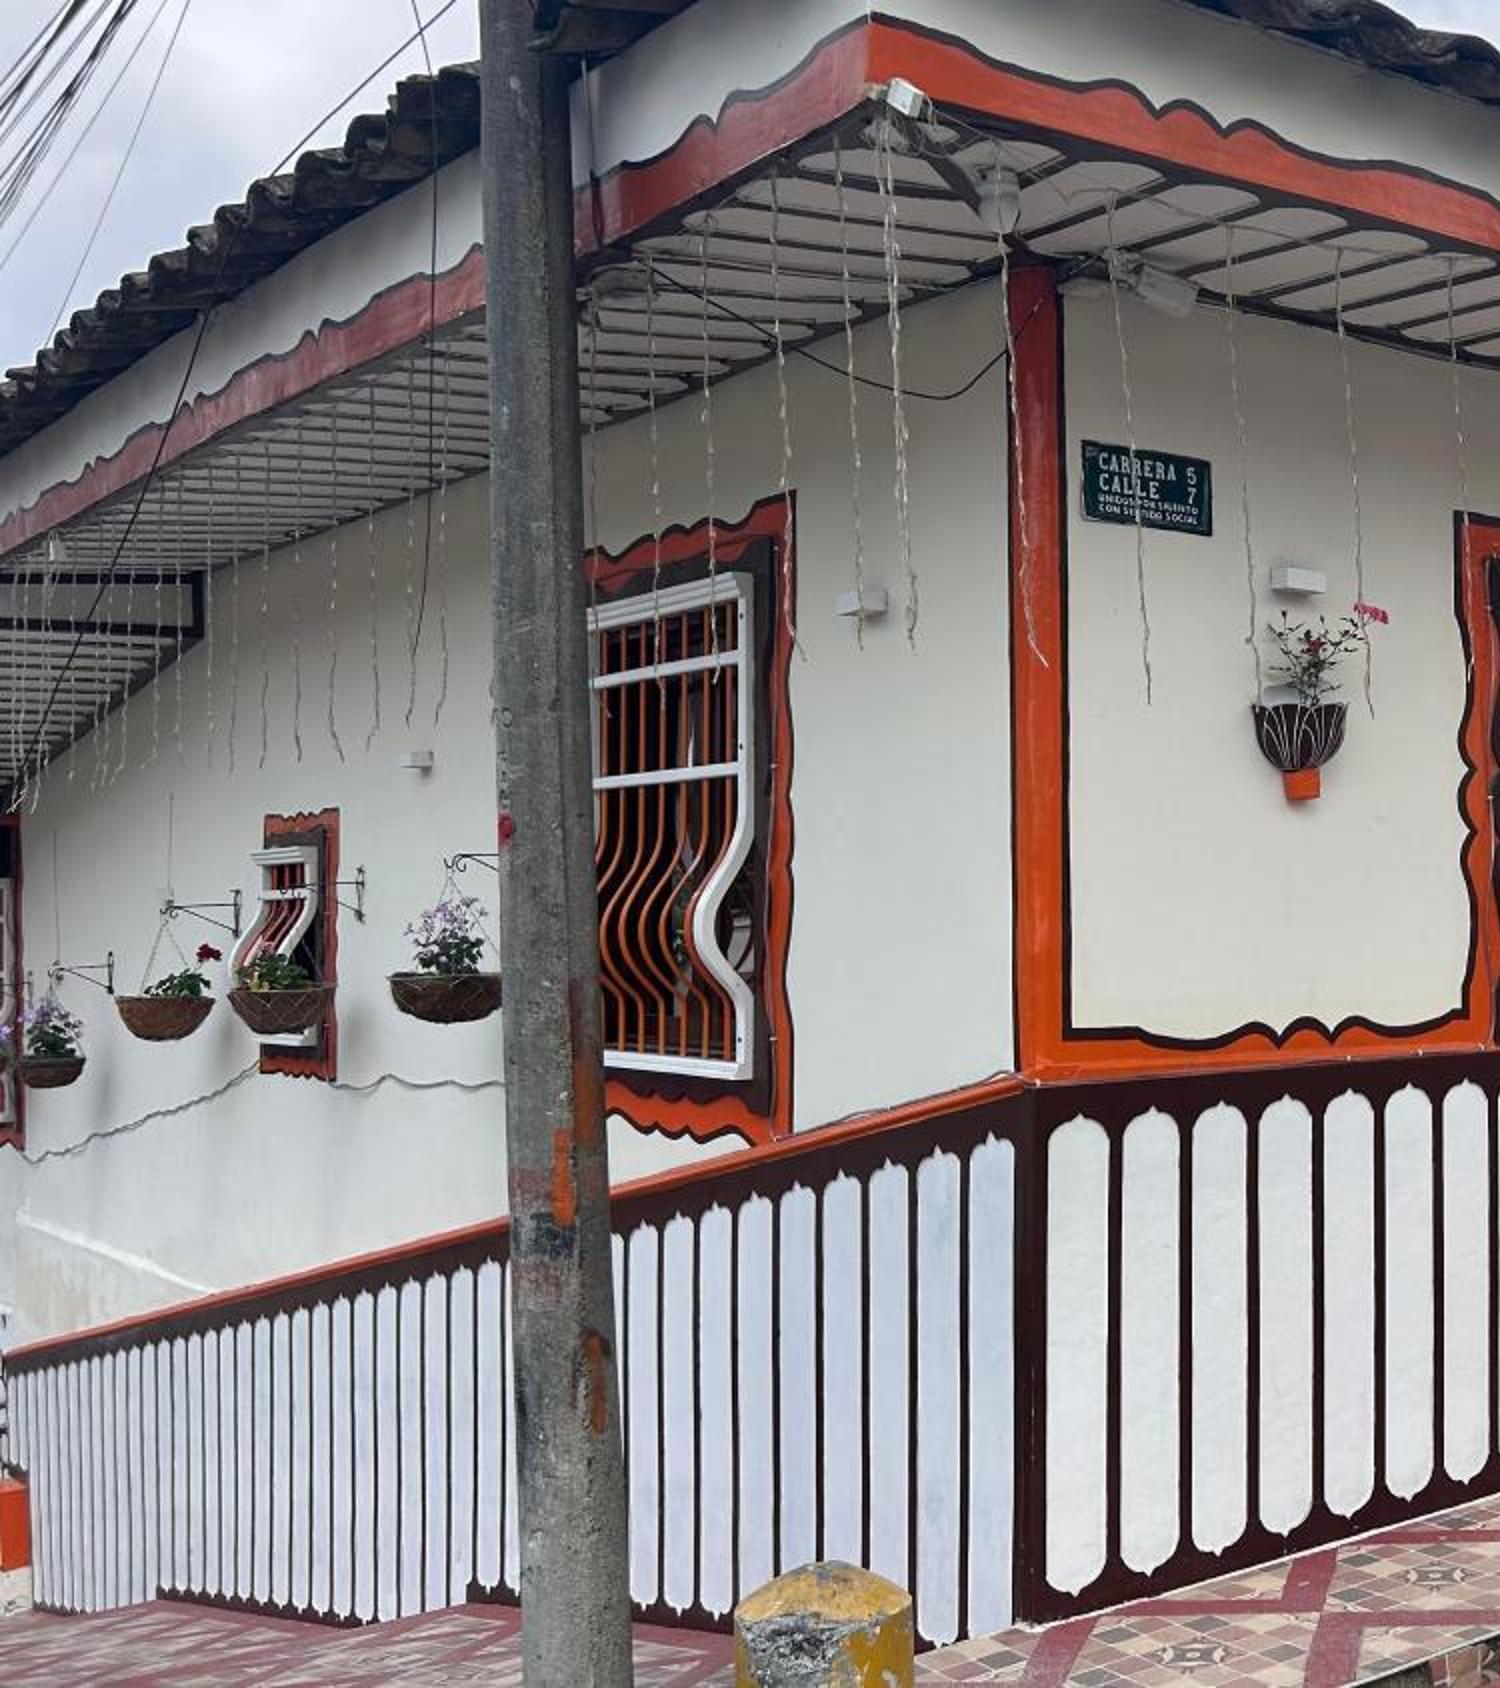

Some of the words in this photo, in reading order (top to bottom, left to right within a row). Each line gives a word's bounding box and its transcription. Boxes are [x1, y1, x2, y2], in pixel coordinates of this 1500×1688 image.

[1099, 452, 1177, 481] CARRERA
[1187, 467, 1197, 485] 5
[1099, 473, 1160, 499] CALLE
[1187, 487, 1198, 505] 7
[1099, 503, 1121, 514] CON
[1123, 507, 1162, 519] SETIDO
[1165, 512, 1198, 525] SOCIAL
